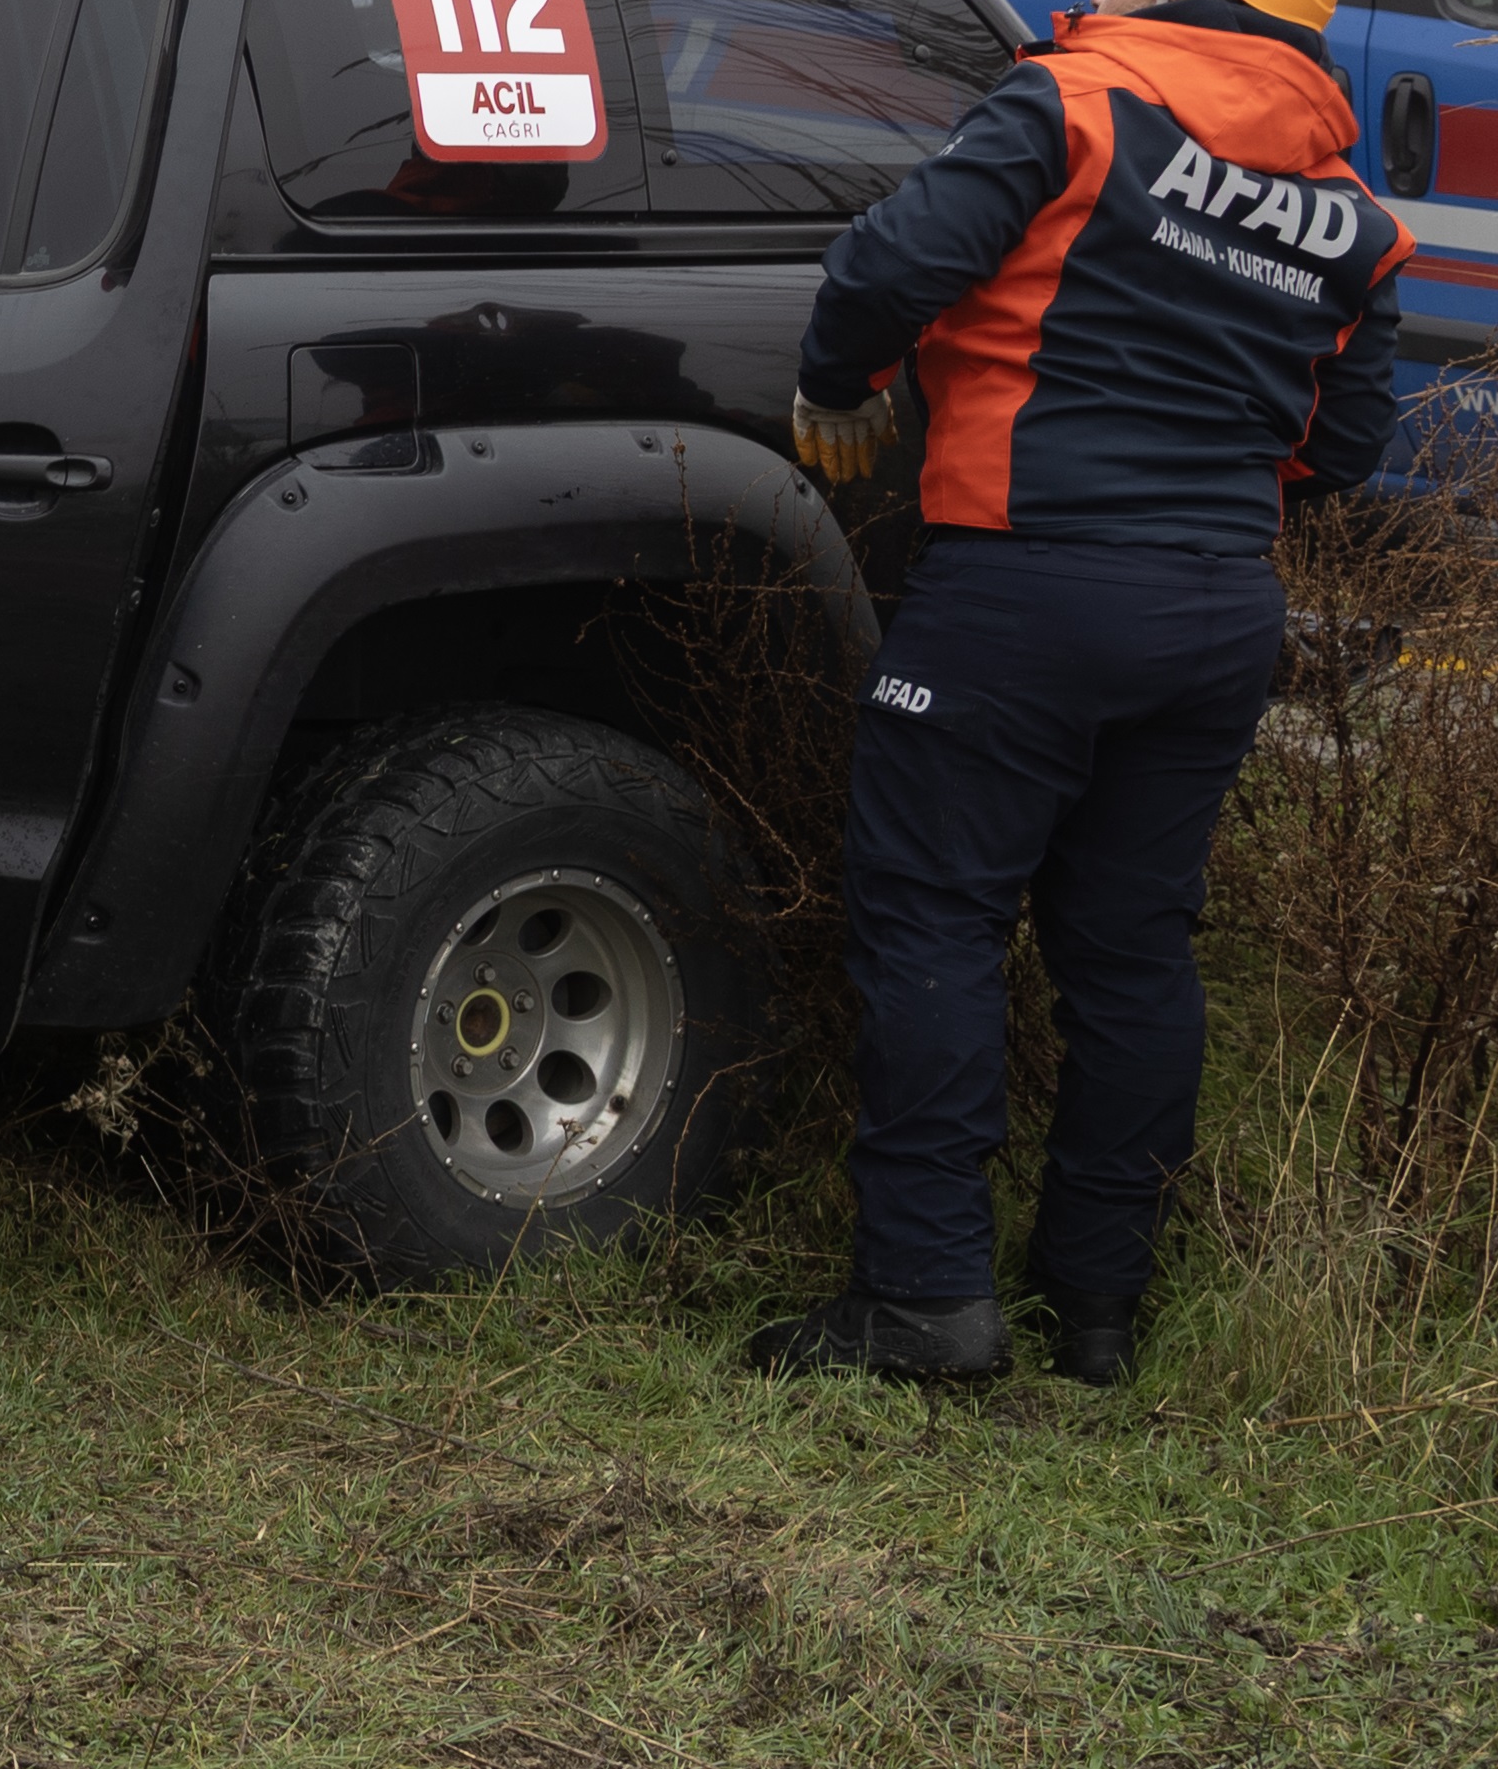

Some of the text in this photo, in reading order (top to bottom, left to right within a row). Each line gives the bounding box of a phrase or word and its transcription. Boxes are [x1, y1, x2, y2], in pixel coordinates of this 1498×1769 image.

[472, 81, 546, 115] ACİL
[482, 119, 541, 142] ÇAĞRI
[1148, 136, 1358, 259] AFAD
[1151, 216, 1217, 265] ARAMA
[1226, 245, 1324, 304] KURTARMA
[871, 675, 932, 714] AFAD
